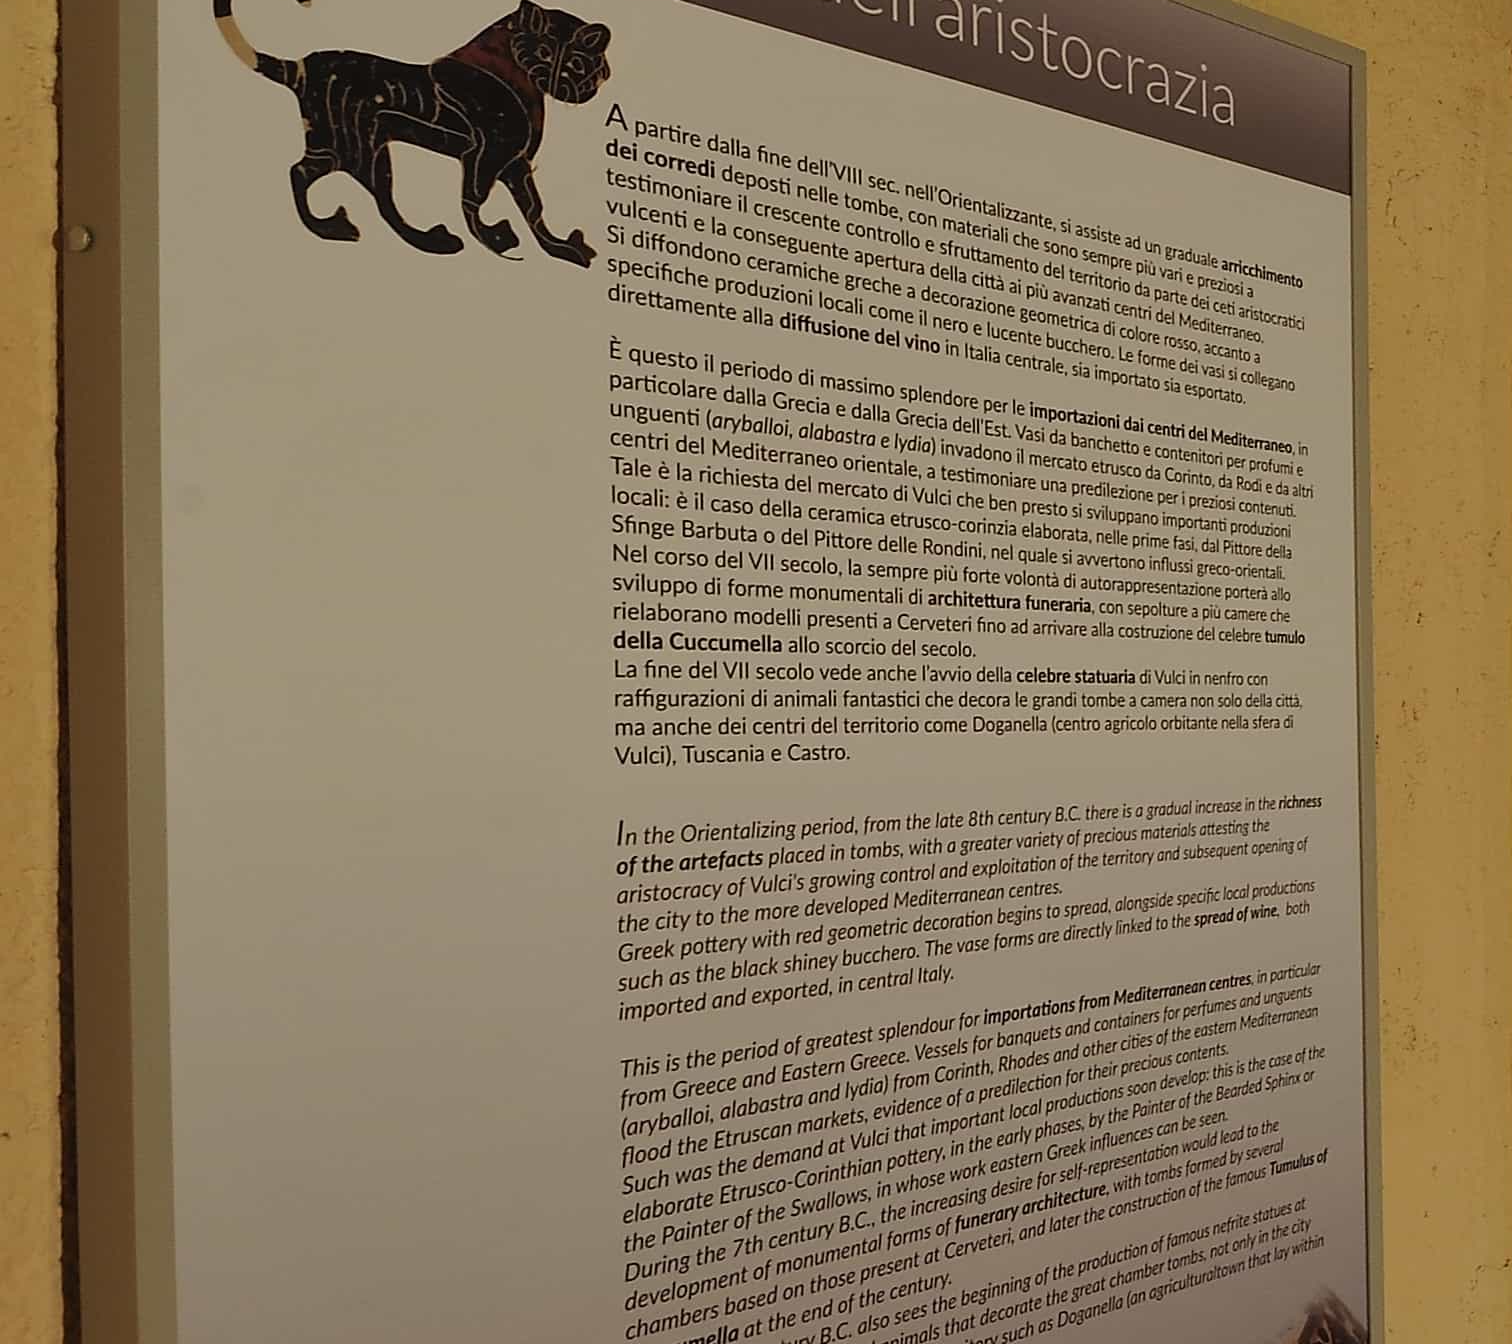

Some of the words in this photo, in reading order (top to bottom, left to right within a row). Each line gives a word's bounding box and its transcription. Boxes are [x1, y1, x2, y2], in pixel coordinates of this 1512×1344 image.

[605, 103, 629, 131] A
[635, 120, 701, 148] partire
[707, 134, 751, 159] dalla
[757, 145, 792, 169] fine
[868, 175, 900, 195] sec.
[1060, 218, 1071, 233] si
[1075, 224, 1121, 246] assiste
[1124, 235, 1141, 250] ad
[1144, 241, 1161, 255] un
[1165, 246, 1218, 269] graduale
[1221, 259, 1304, 289] arricchimento
[613, 630, 663, 650] della
[669, 632, 782, 653] Cuccumella
[788, 635, 820, 654] allo
[825, 638, 886, 656] scorcio
[891, 639, 916, 657] del
[921, 640, 977, 658] secolo.
[614, 659, 637, 678] La
[644, 659, 682, 679] fine
[688, 660, 717, 679] del
[722, 661, 749, 680] VII
[756, 662, 814, 681] secolo
[819, 663, 862, 681] vede
[866, 664, 917, 682] anche
[976, 666, 1012, 683] della
[1016, 666, 1071, 684] celebre
[1074, 668, 1136, 684] statuaria
[1139, 669, 1152, 685] di
[1154, 670, 1186, 685] Vulci
[1189, 670, 1201, 685] in
[1204, 671, 1244, 686] nenfro
[1246, 675, 1268, 686] con
[617, 819, 637, 847] In
[644, 825, 675, 845] the
[680, 820, 796, 843] Orientalizing
[800, 815, 859, 840] period,
[863, 815, 901, 835] from
[906, 813, 931, 831] the
[935, 812, 964, 829] late
[968, 809, 994, 827] 8th
[998, 810, 1052, 826] century
[1085, 805, 1119, 821] there
[1122, 803, 1132, 818] is
[1135, 806, 1144, 818] a
[1146, 800, 1193, 821] gradual
[1195, 799, 1242, 814] increase
[1245, 797, 1255, 811] in
[1258, 796, 1276, 811] the
[1278, 794, 1322, 809] richness
